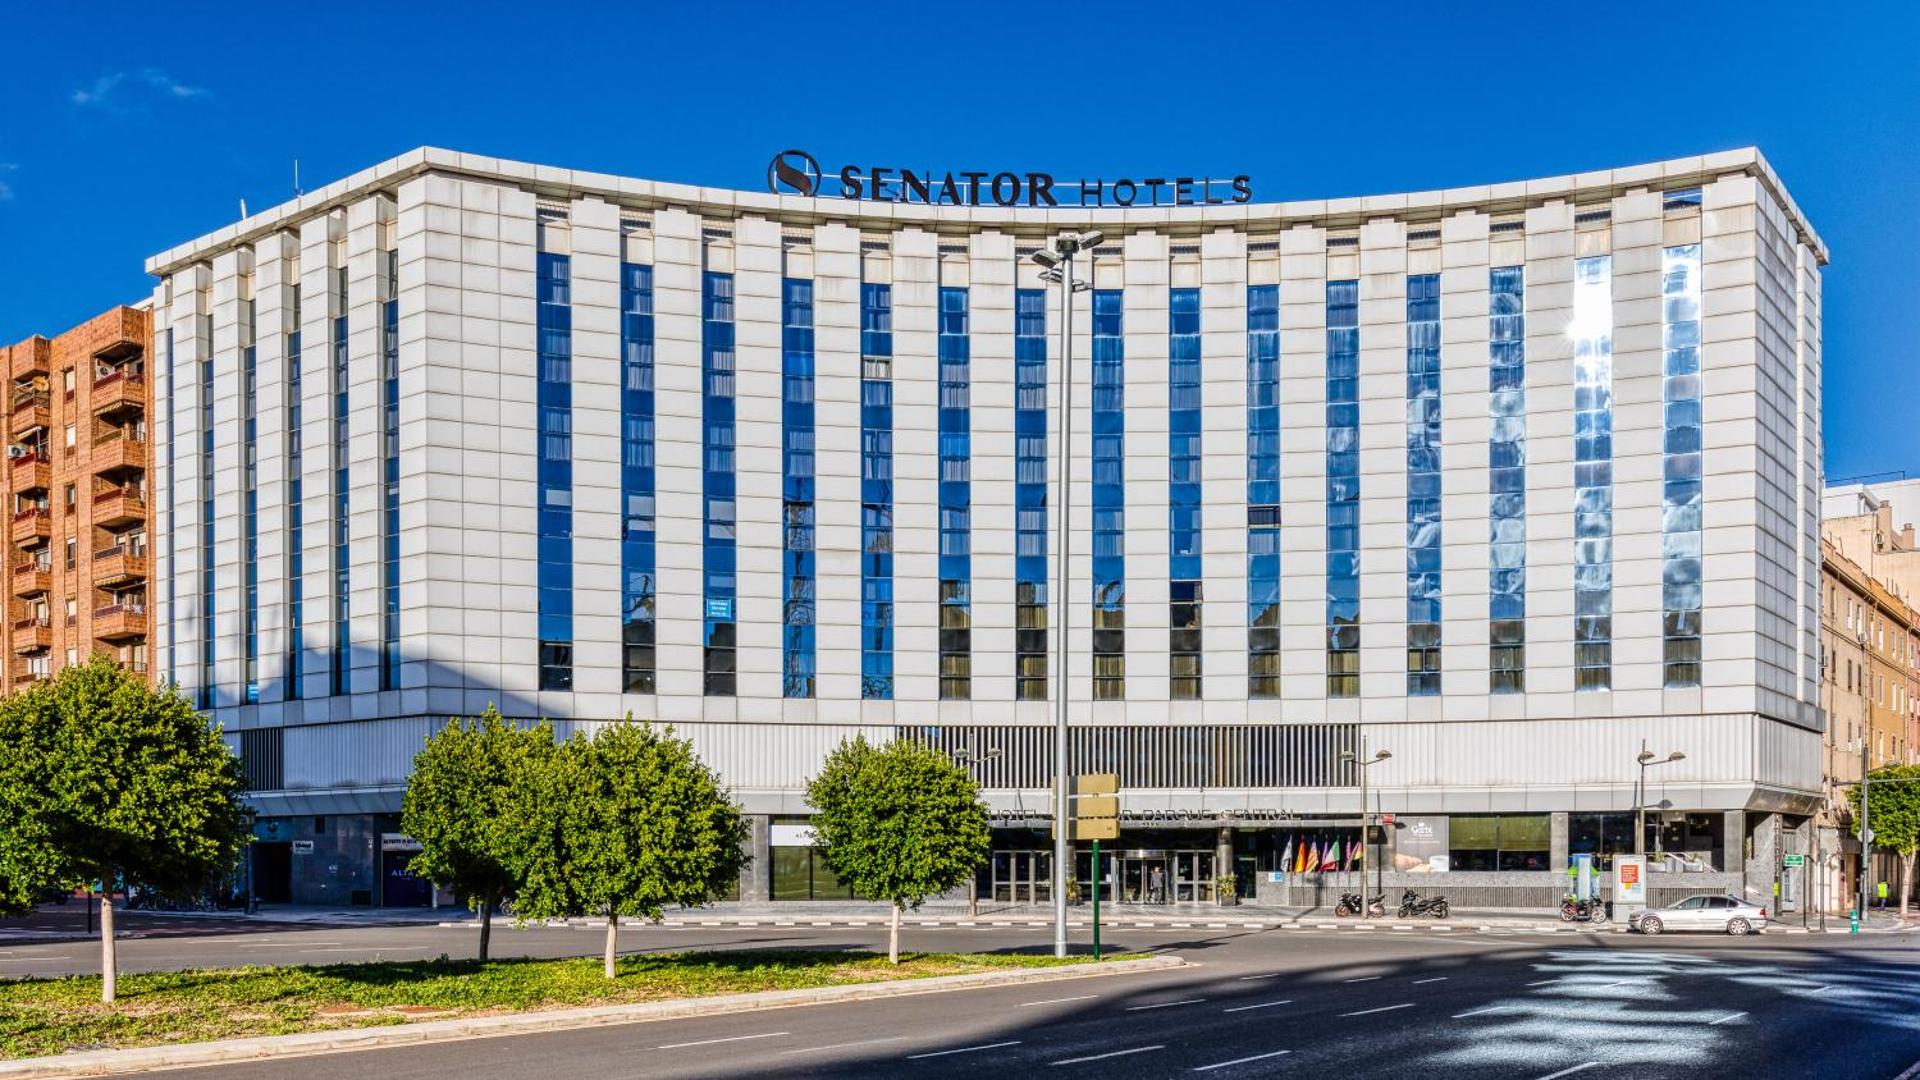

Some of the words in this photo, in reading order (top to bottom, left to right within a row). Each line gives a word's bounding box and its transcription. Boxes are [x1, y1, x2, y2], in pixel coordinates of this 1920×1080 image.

[840, 165, 1059, 207] SENATOR
[1081, 174, 1252, 208] HOTELS
[990, 809, 1038, 821] HOTEL
[1143, 809, 1211, 821] PARQUE
[1220, 809, 1301, 821] CENTRAL
